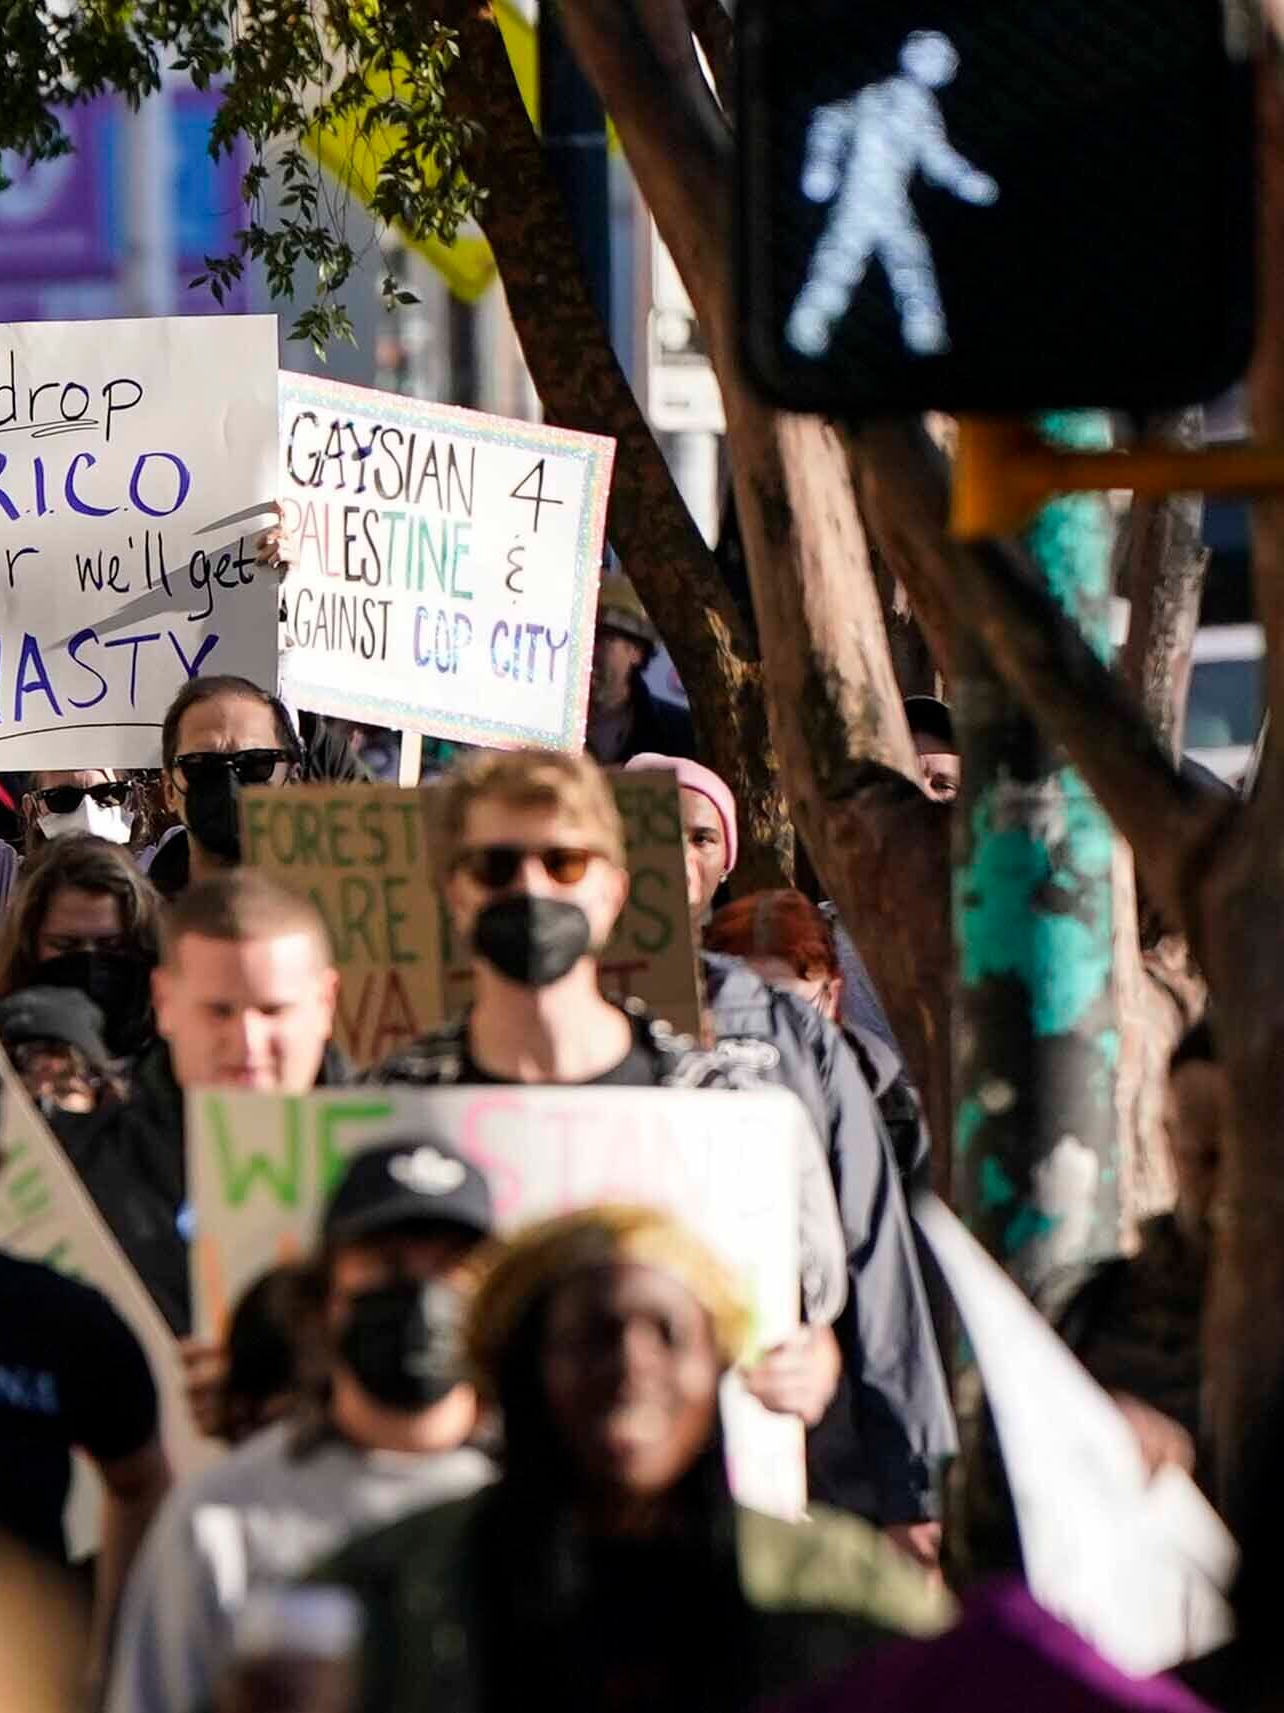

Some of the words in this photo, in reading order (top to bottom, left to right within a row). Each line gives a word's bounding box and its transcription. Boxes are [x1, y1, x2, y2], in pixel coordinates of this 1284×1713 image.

[287, 411, 476, 517] GAYSIAN
[509, 457, 565, 533] 4
[189, 537, 255, 621] get
[413, 606, 473, 674] COP
[490, 620, 569, 684] CITY
[247, 799, 419, 867] FOREST
